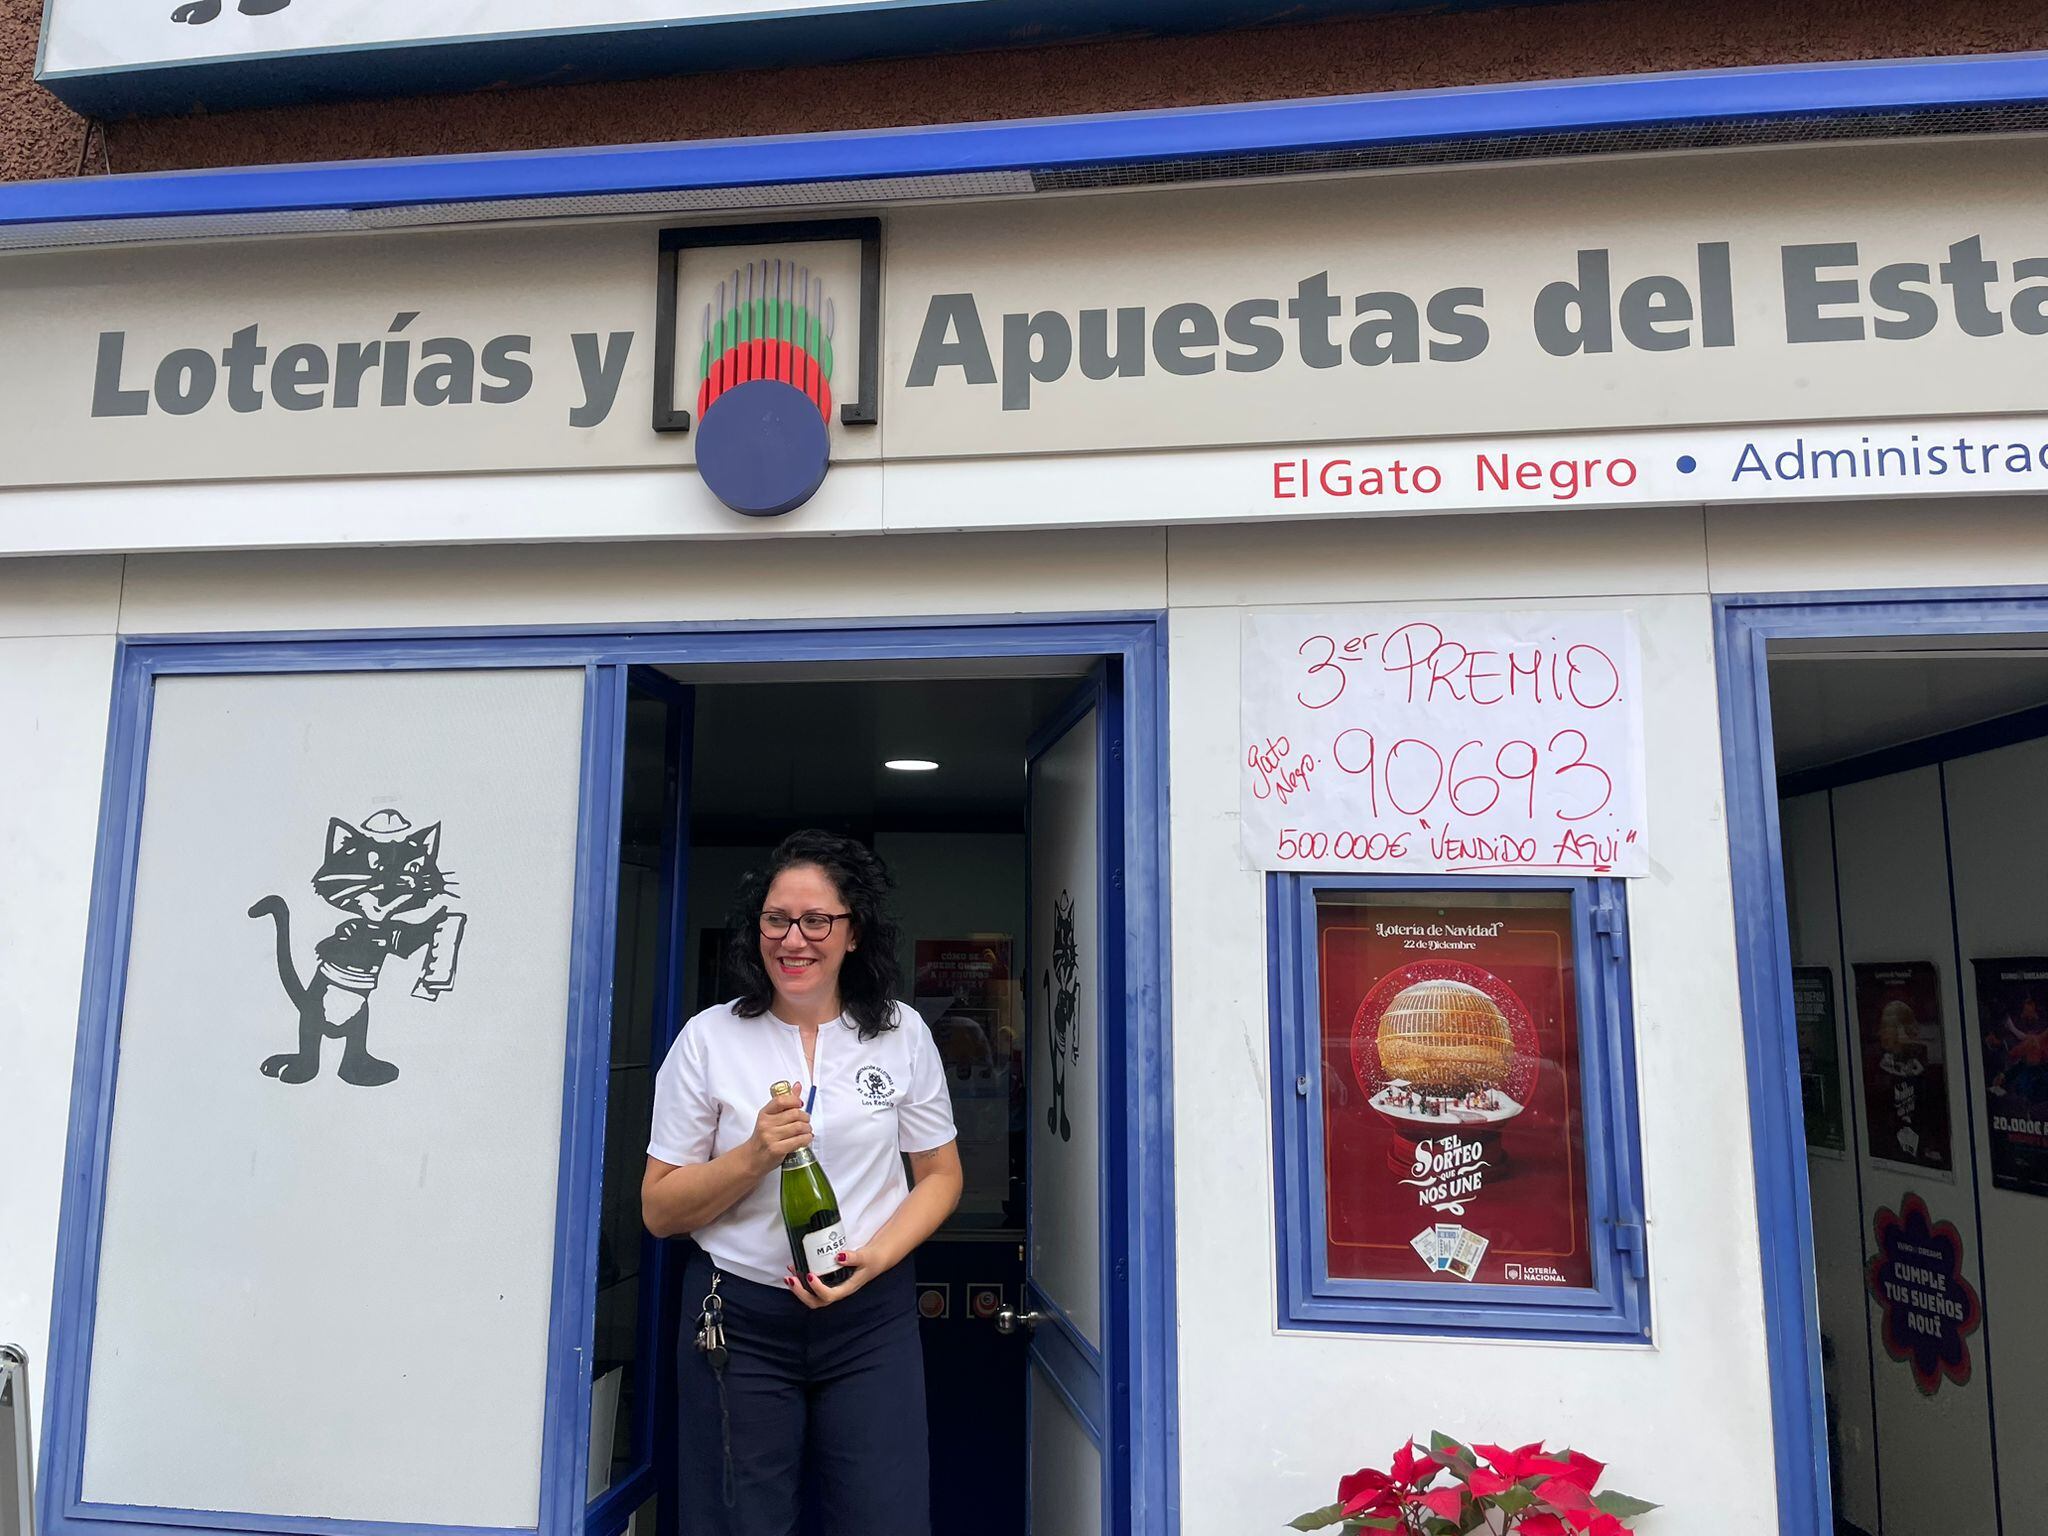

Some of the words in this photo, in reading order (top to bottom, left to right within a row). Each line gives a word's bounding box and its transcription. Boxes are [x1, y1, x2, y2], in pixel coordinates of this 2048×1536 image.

[904, 270, 1490, 411] Apuestas
[1533, 241, 1736, 357] del
[91, 311, 533, 418] Loterías
[569, 331, 635, 428] y
[1477, 453, 1637, 500] Negro
[1376, 922, 1424, 937] Lotería
[1426, 924, 1442, 936] de
[1444, 922, 1504, 937] Navidad
[1403, 939, 1415, 949] 22
[1416, 940, 1427, 949] de
[1428, 940, 1476, 950] Diciembre
[1440, 1134, 1461, 1152] EL
[1419, 1183, 1447, 1206] NOS
[1449, 1171, 1482, 1197] UNE
[1439, 1169, 1456, 1181] QUE
[1523, 1274, 1566, 1282] NACIONAL
[1893, 1262, 1947, 1292] CUMPLE
[1884, 1281, 1910, 1304] TUS
[1910, 1290, 1965, 1321] SUEÑOS
